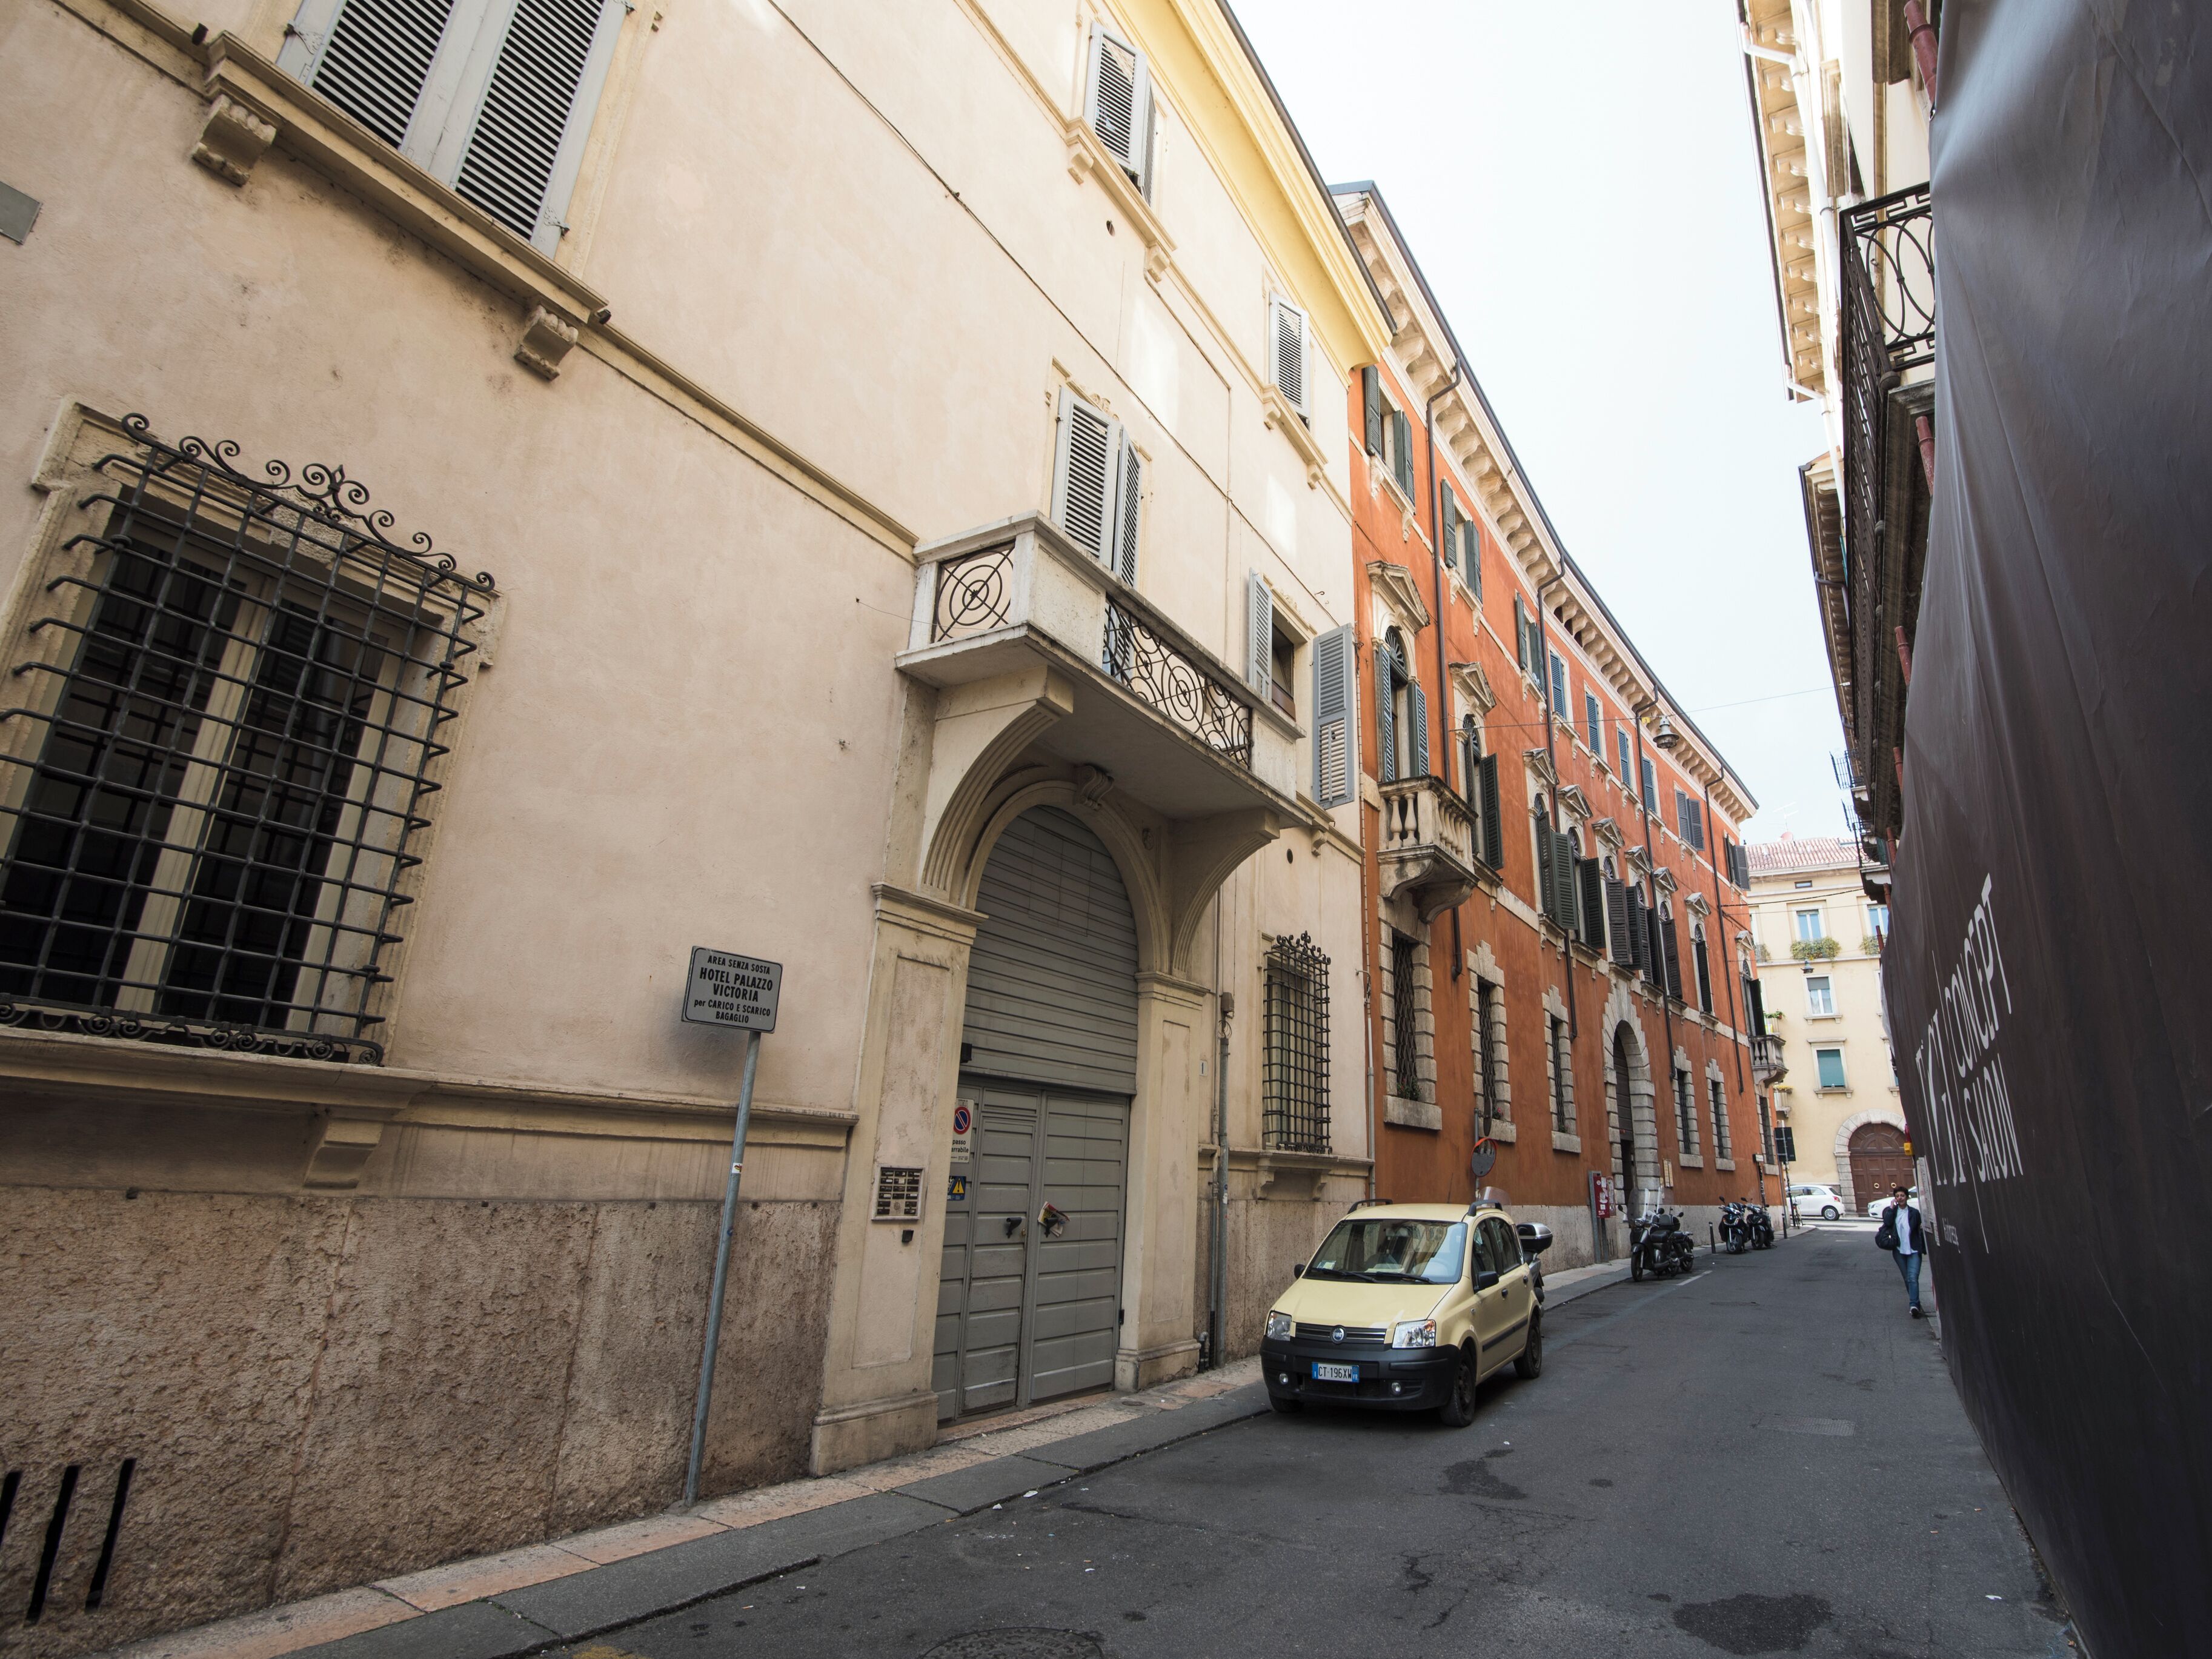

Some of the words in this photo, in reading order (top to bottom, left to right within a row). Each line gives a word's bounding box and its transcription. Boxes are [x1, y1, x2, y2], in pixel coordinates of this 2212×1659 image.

[707, 955, 726, 966] AREA
[728, 959, 749, 971] SENZA
[751, 963, 770, 974] SOSTA
[699, 967, 730, 983] HOTEL
[734, 974, 773, 991] PALAZZO
[1945, 873, 2011, 1079] CONCEPT
[713, 983, 759, 1002] VICTORIA
[694, 999, 706, 1008] per
[708, 1000, 734, 1011] CARICO
[742, 1005, 771, 1017] SCARICO
[716, 1011, 749, 1023] BAGAGLIO
[1964, 1052, 2024, 1182] SALON
